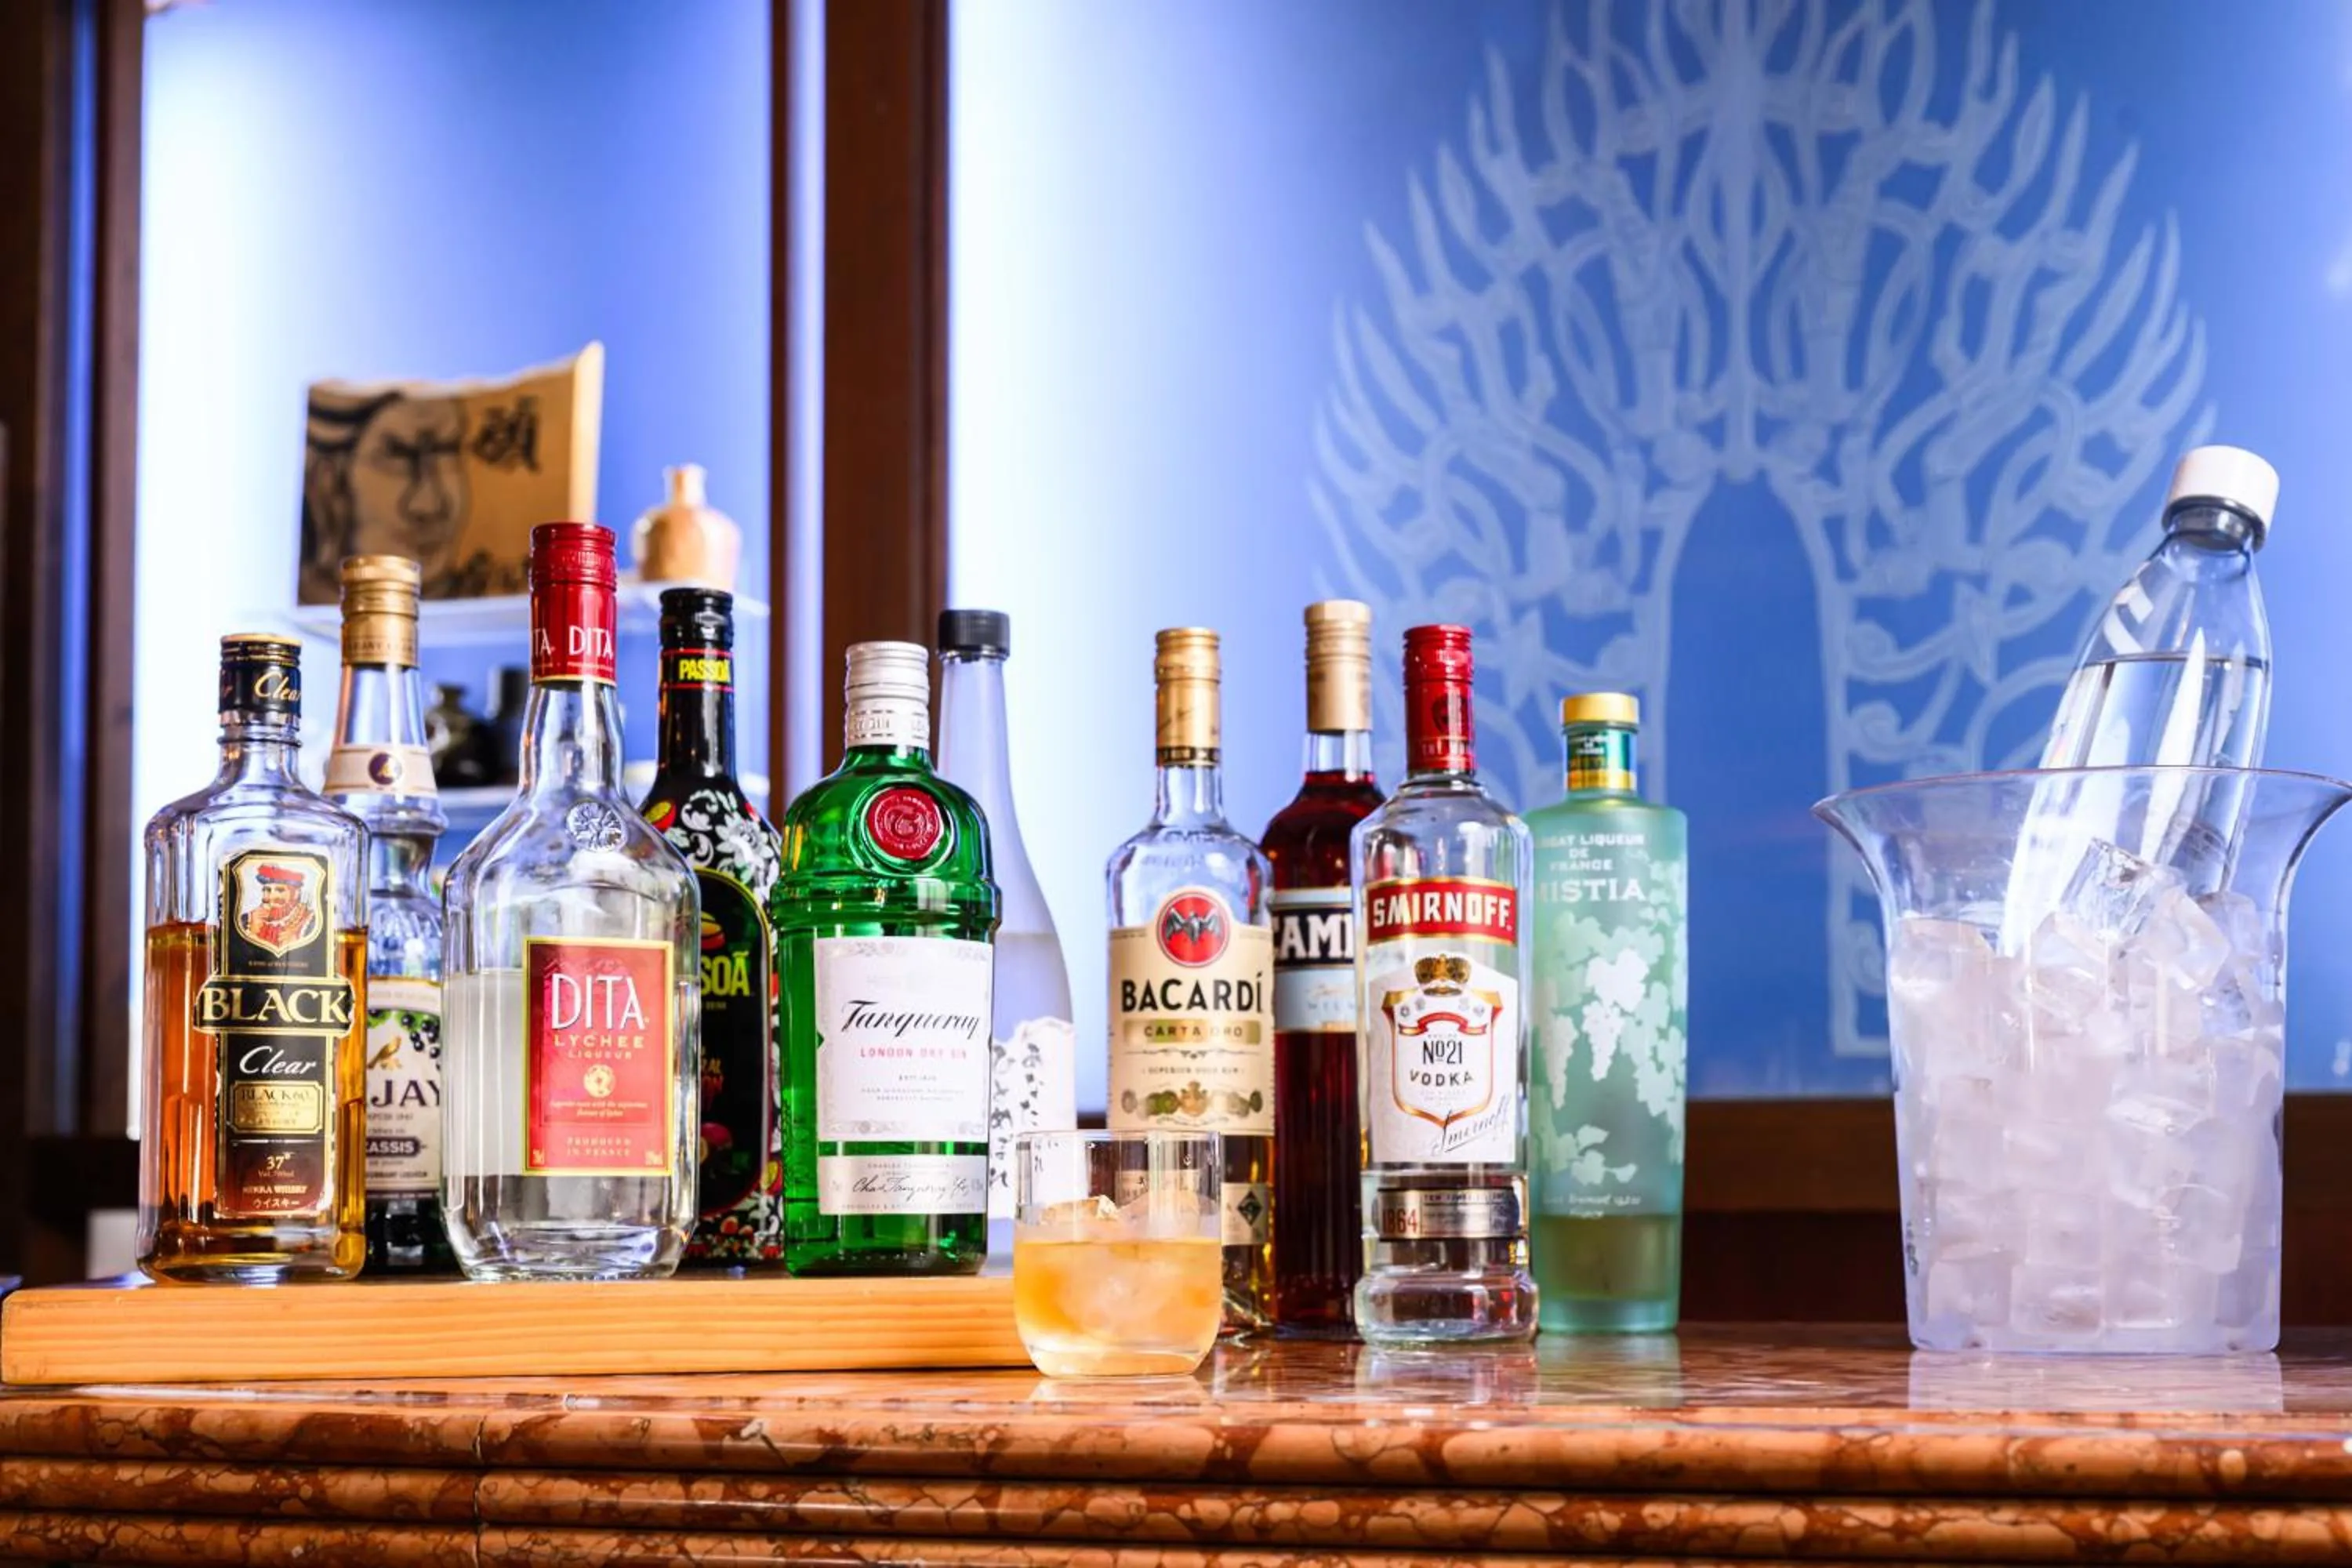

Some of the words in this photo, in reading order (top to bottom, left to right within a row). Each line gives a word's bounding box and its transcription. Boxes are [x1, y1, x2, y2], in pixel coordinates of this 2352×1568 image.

[569, 625, 613, 659] DITA
[1570, 848, 1588, 858] DE
[1581, 834, 1644, 846] LIQUEUR
[1549, 859, 1613, 871] FRANCE
[1373, 891, 1512, 928] SMIRNOFF
[202, 987, 350, 1023] BLACK
[552, 973, 645, 1029] DITA
[1121, 971, 1263, 1013] BACARDÍ
[841, 1000, 979, 1040] Tanqueray
[1144, 1025, 1201, 1037] CARTA
[554, 1034, 645, 1049] LYCHEE
[859, 1047, 913, 1058] LONDON
[239, 1045, 317, 1074] Clear
[1410, 1069, 1474, 1087] VODKA
[1382, 1208, 1417, 1235] 1864
